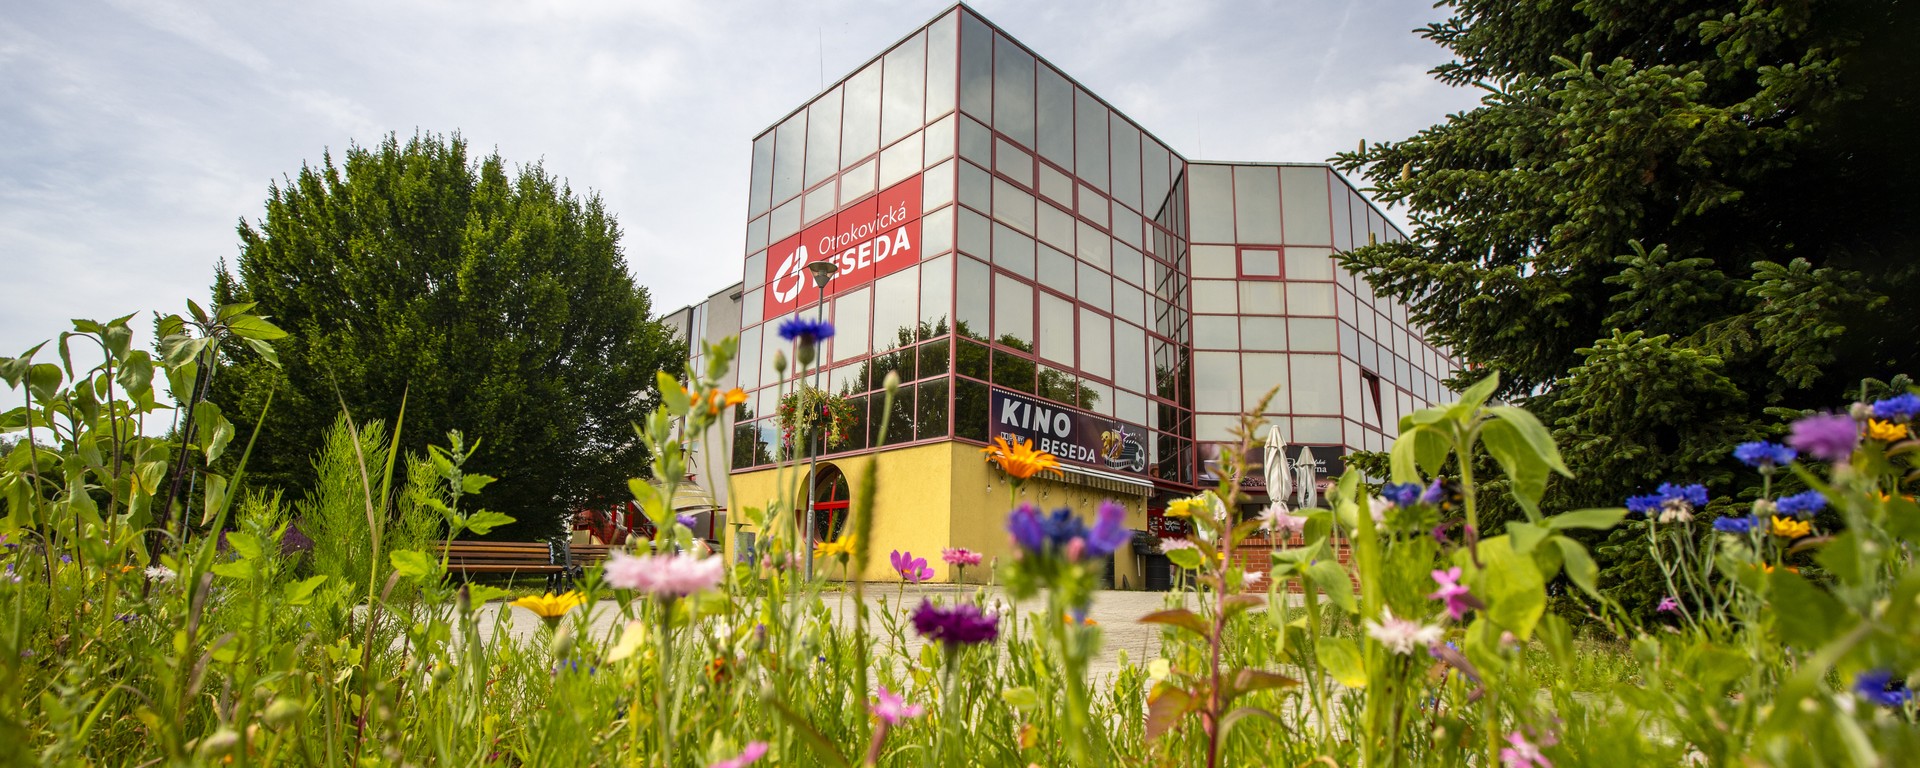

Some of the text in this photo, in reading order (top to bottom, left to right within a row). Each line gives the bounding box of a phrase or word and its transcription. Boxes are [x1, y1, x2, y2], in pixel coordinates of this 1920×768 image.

[819, 201, 907, 255] Otrokovická
[812, 226, 911, 288] ESEDA
[1001, 398, 1071, 438] KINO
[1041, 438, 1096, 463] BESEDA
